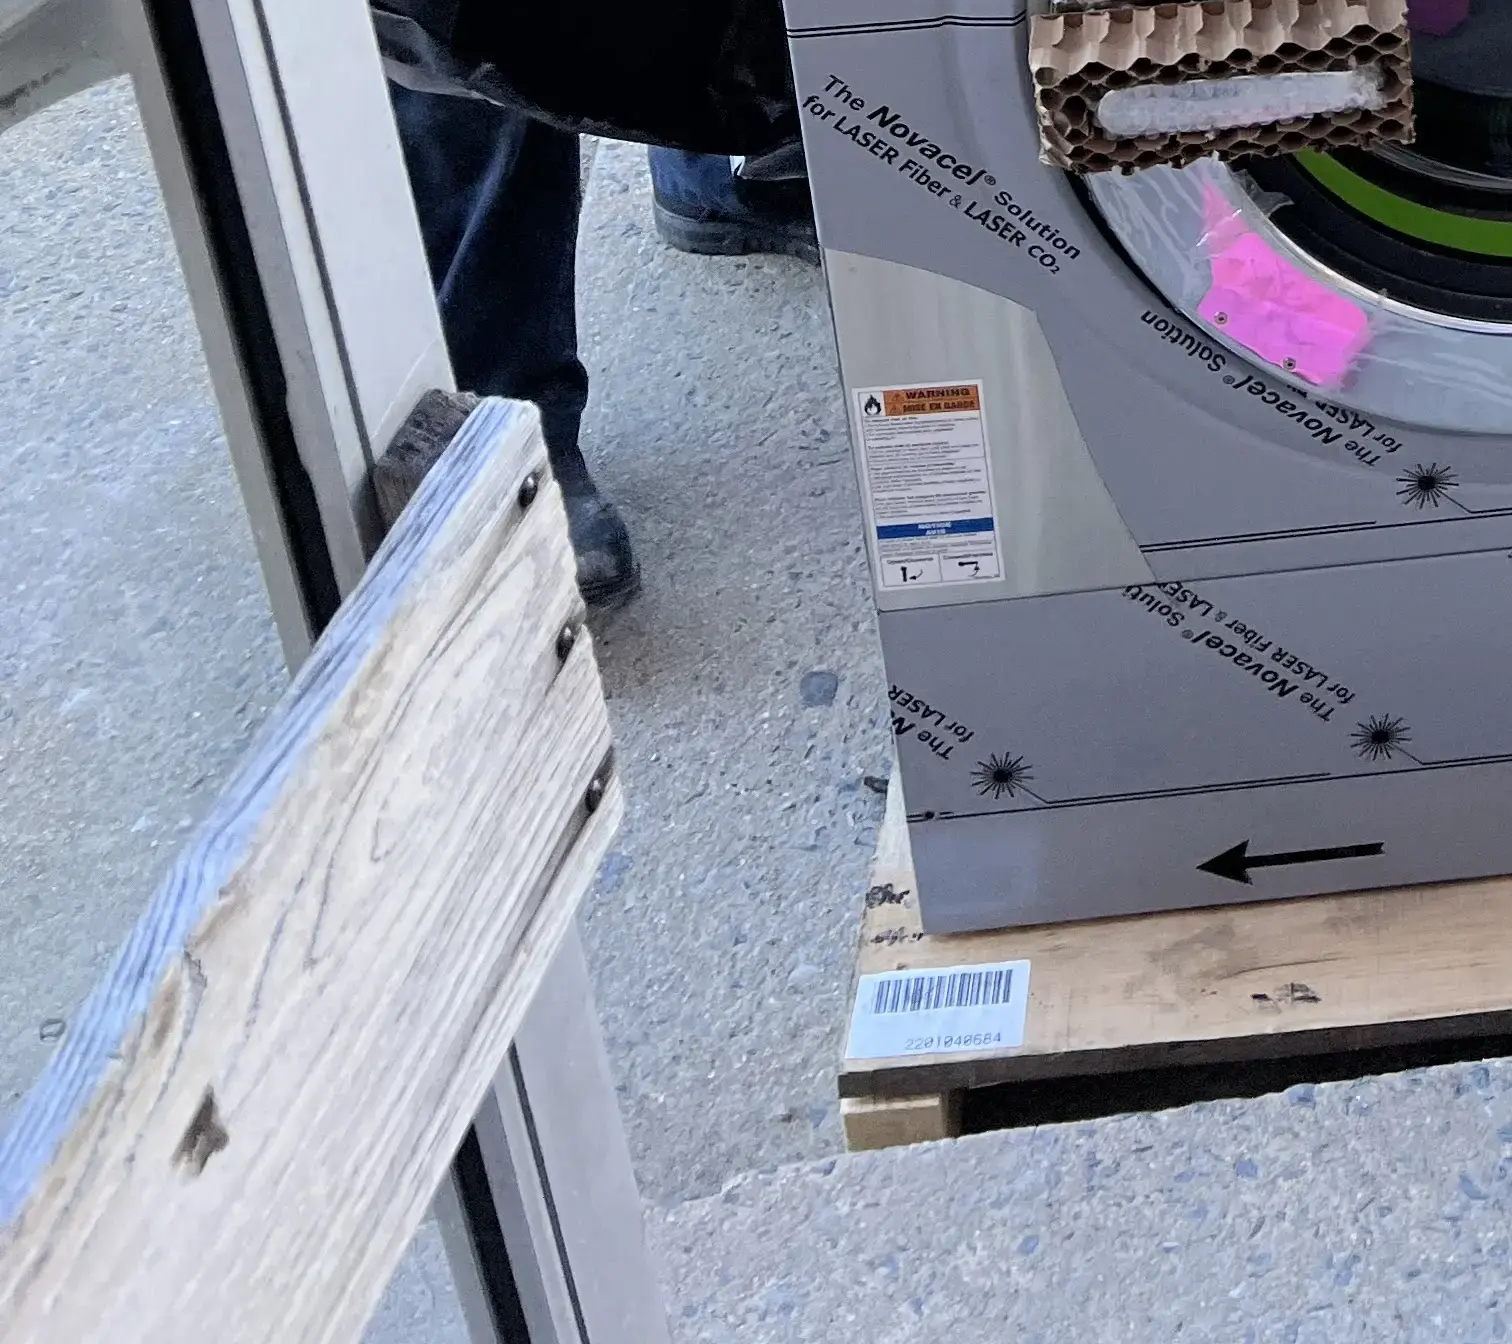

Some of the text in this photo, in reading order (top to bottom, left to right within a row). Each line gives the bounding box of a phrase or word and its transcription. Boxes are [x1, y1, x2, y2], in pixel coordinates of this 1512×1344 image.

[803, 96, 836, 120] for
[833, 116, 899, 165] LASER
[899, 159, 951, 197] Fiber
[949, 195, 962, 209] &
[963, 201, 1026, 247] LASER
[825, 75, 864, 110] The
[994, 191, 1080, 259] Solution
[1141, 310, 1227, 372] Solution
[905, 388, 970, 399] WARNING
[1344, 441, 1381, 466] The
[1372, 434, 1403, 453] for
[1225, 620, 1272, 652] Fiber
[1271, 647, 1328, 688] LASER
[888, 685, 946, 727] LASER
[1300, 692, 1335, 721] The
[1326, 684, 1355, 704] for
[918, 731, 954, 760] The
[944, 722, 974, 742] for
